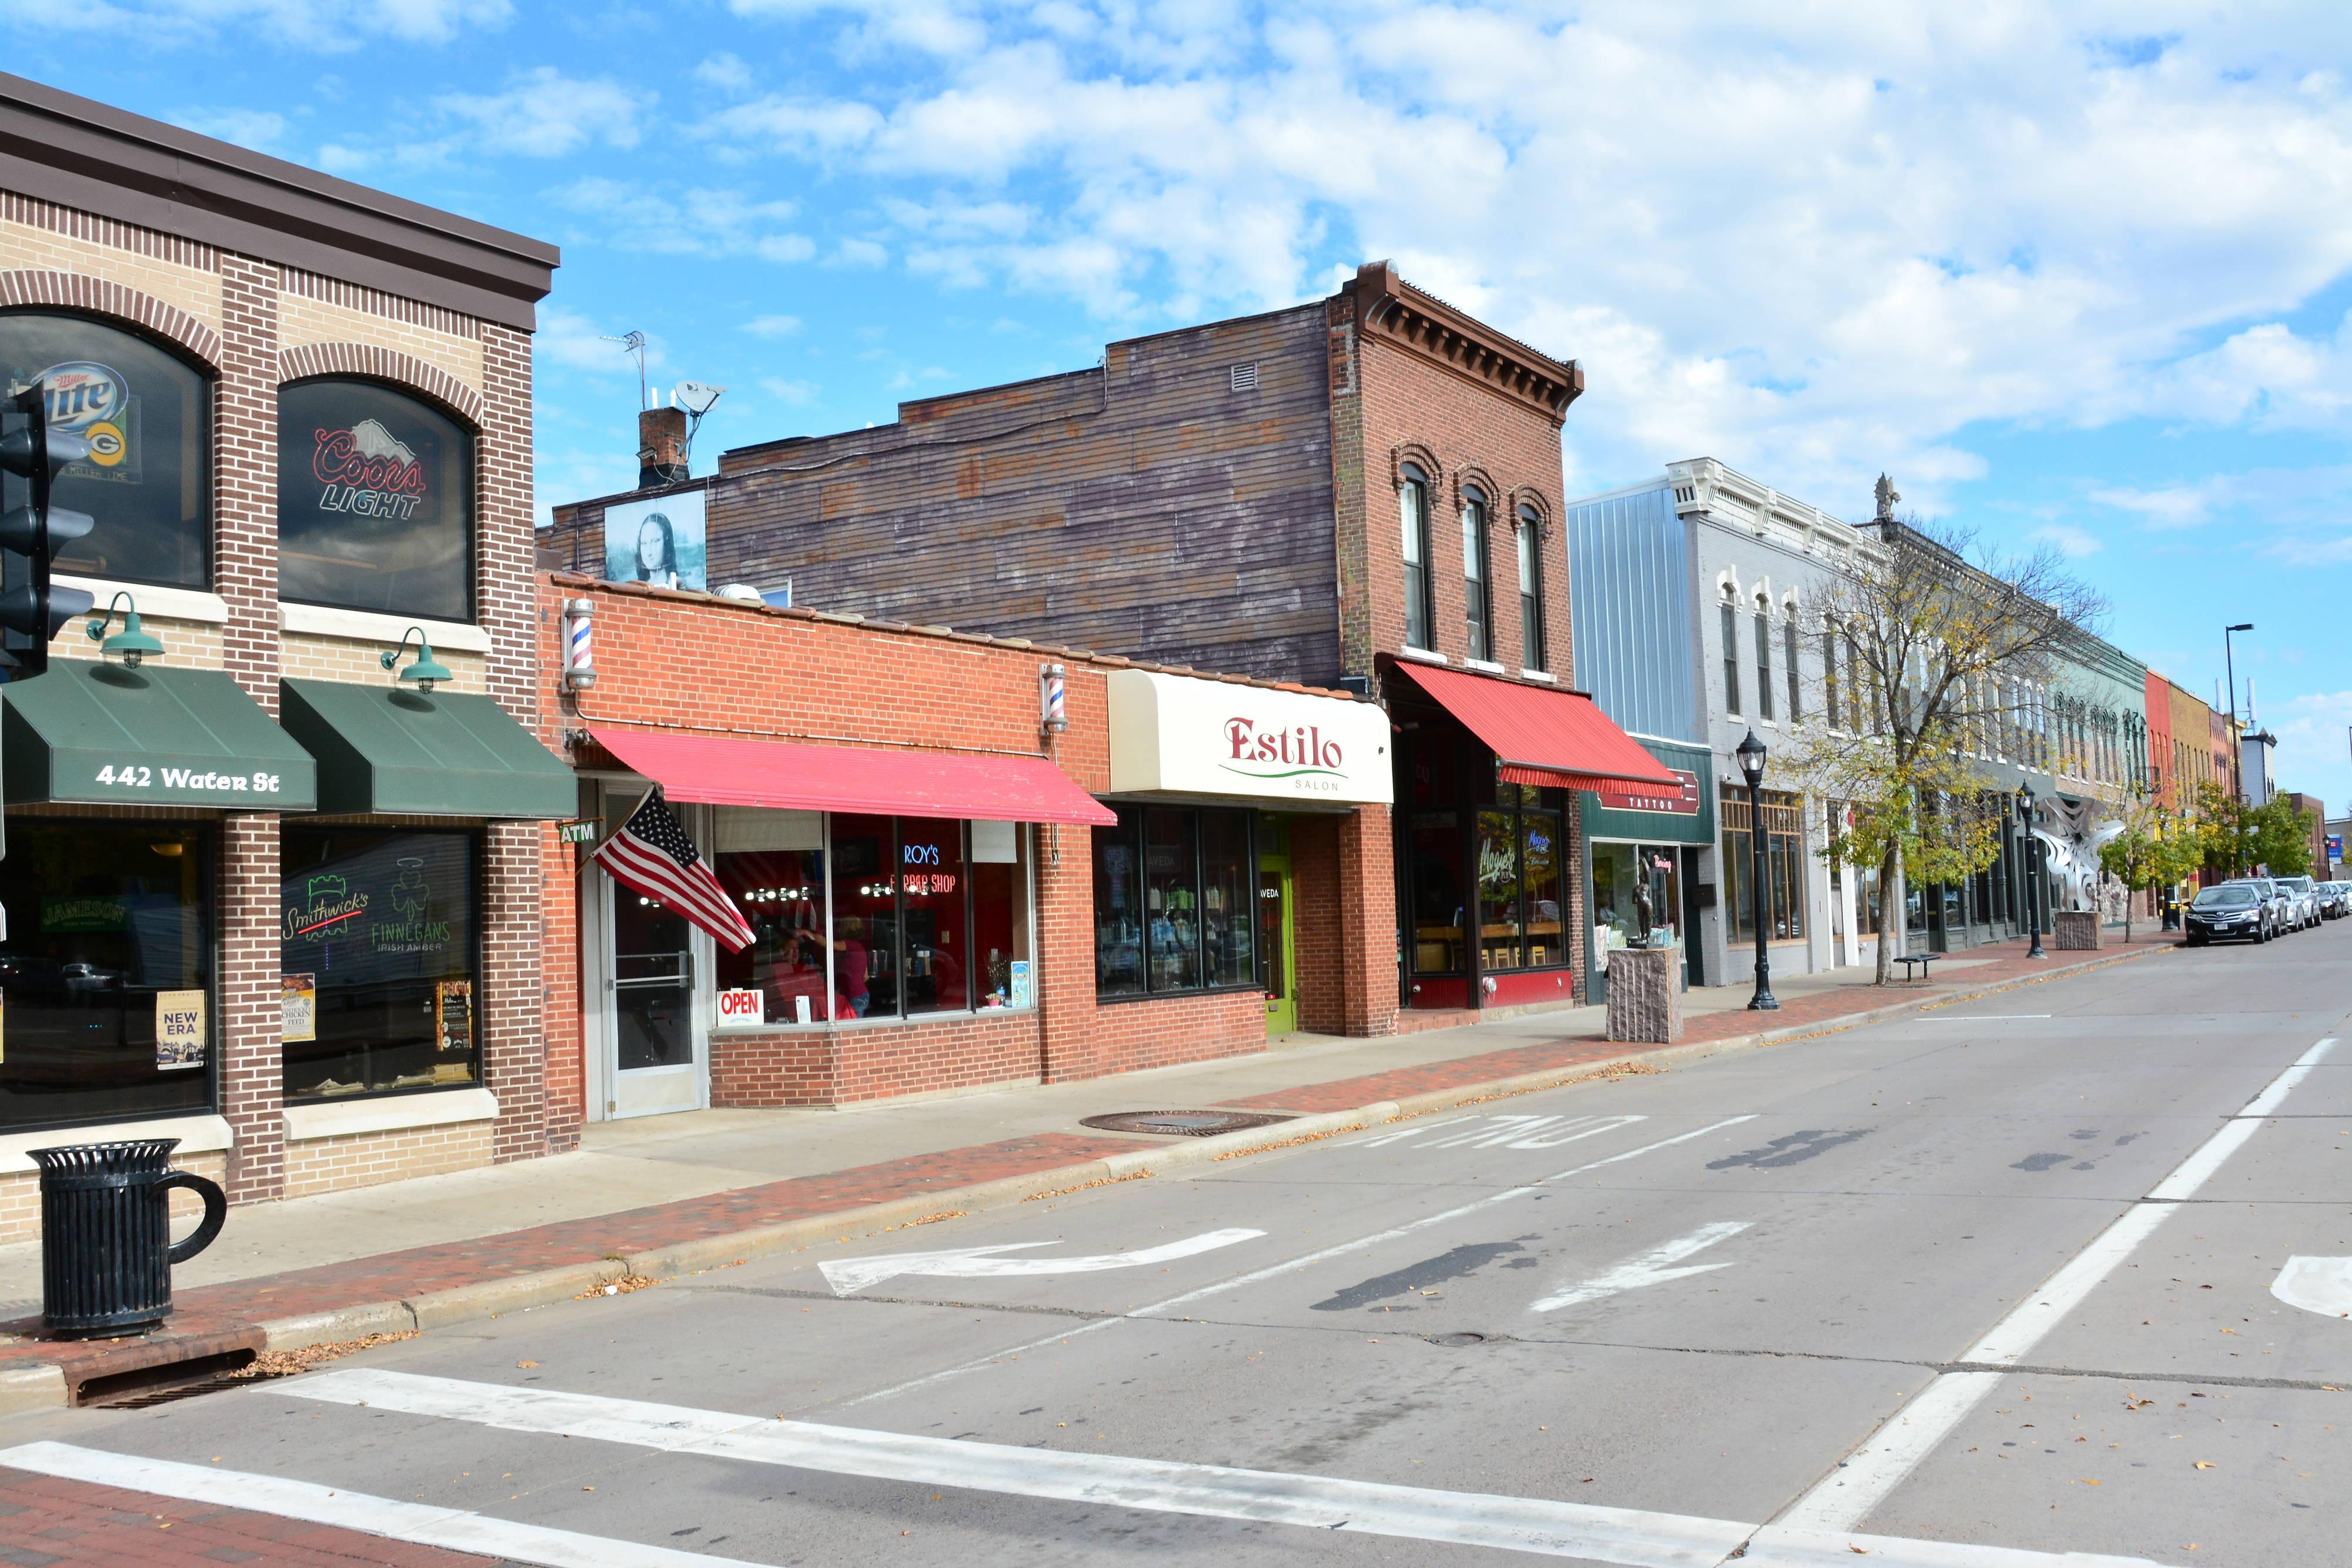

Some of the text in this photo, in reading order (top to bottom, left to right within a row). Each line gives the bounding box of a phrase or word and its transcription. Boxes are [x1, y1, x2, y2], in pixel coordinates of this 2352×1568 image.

[54, 374, 89, 388] Miller
[44, 382, 111, 427] Lite
[313, 429, 426, 495] Coors
[319, 484, 420, 520] LIGHT
[1224, 717, 1342, 768] Estilo
[96, 765, 280, 792] 442 Water St
[1295, 780, 1338, 791] SALON
[1629, 798, 1672, 810] TATTOO
[561, 824, 593, 843] ATM
[904, 844, 939, 865] ROY'S
[1148, 855, 1176, 866] AVEDA
[1479, 837, 1515, 882] Mogie's
[931, 874, 956, 892] SHOP
[44, 900, 126, 925] JAMESON
[283, 892, 369, 940] Smithwick's
[372, 921, 450, 945] FINNEGANS
[407, 943, 442, 951] AMBER
[721, 992, 758, 1015] OPEN
[164, 1012, 198, 1024] NEW
[167, 1024, 196, 1035] ERA
